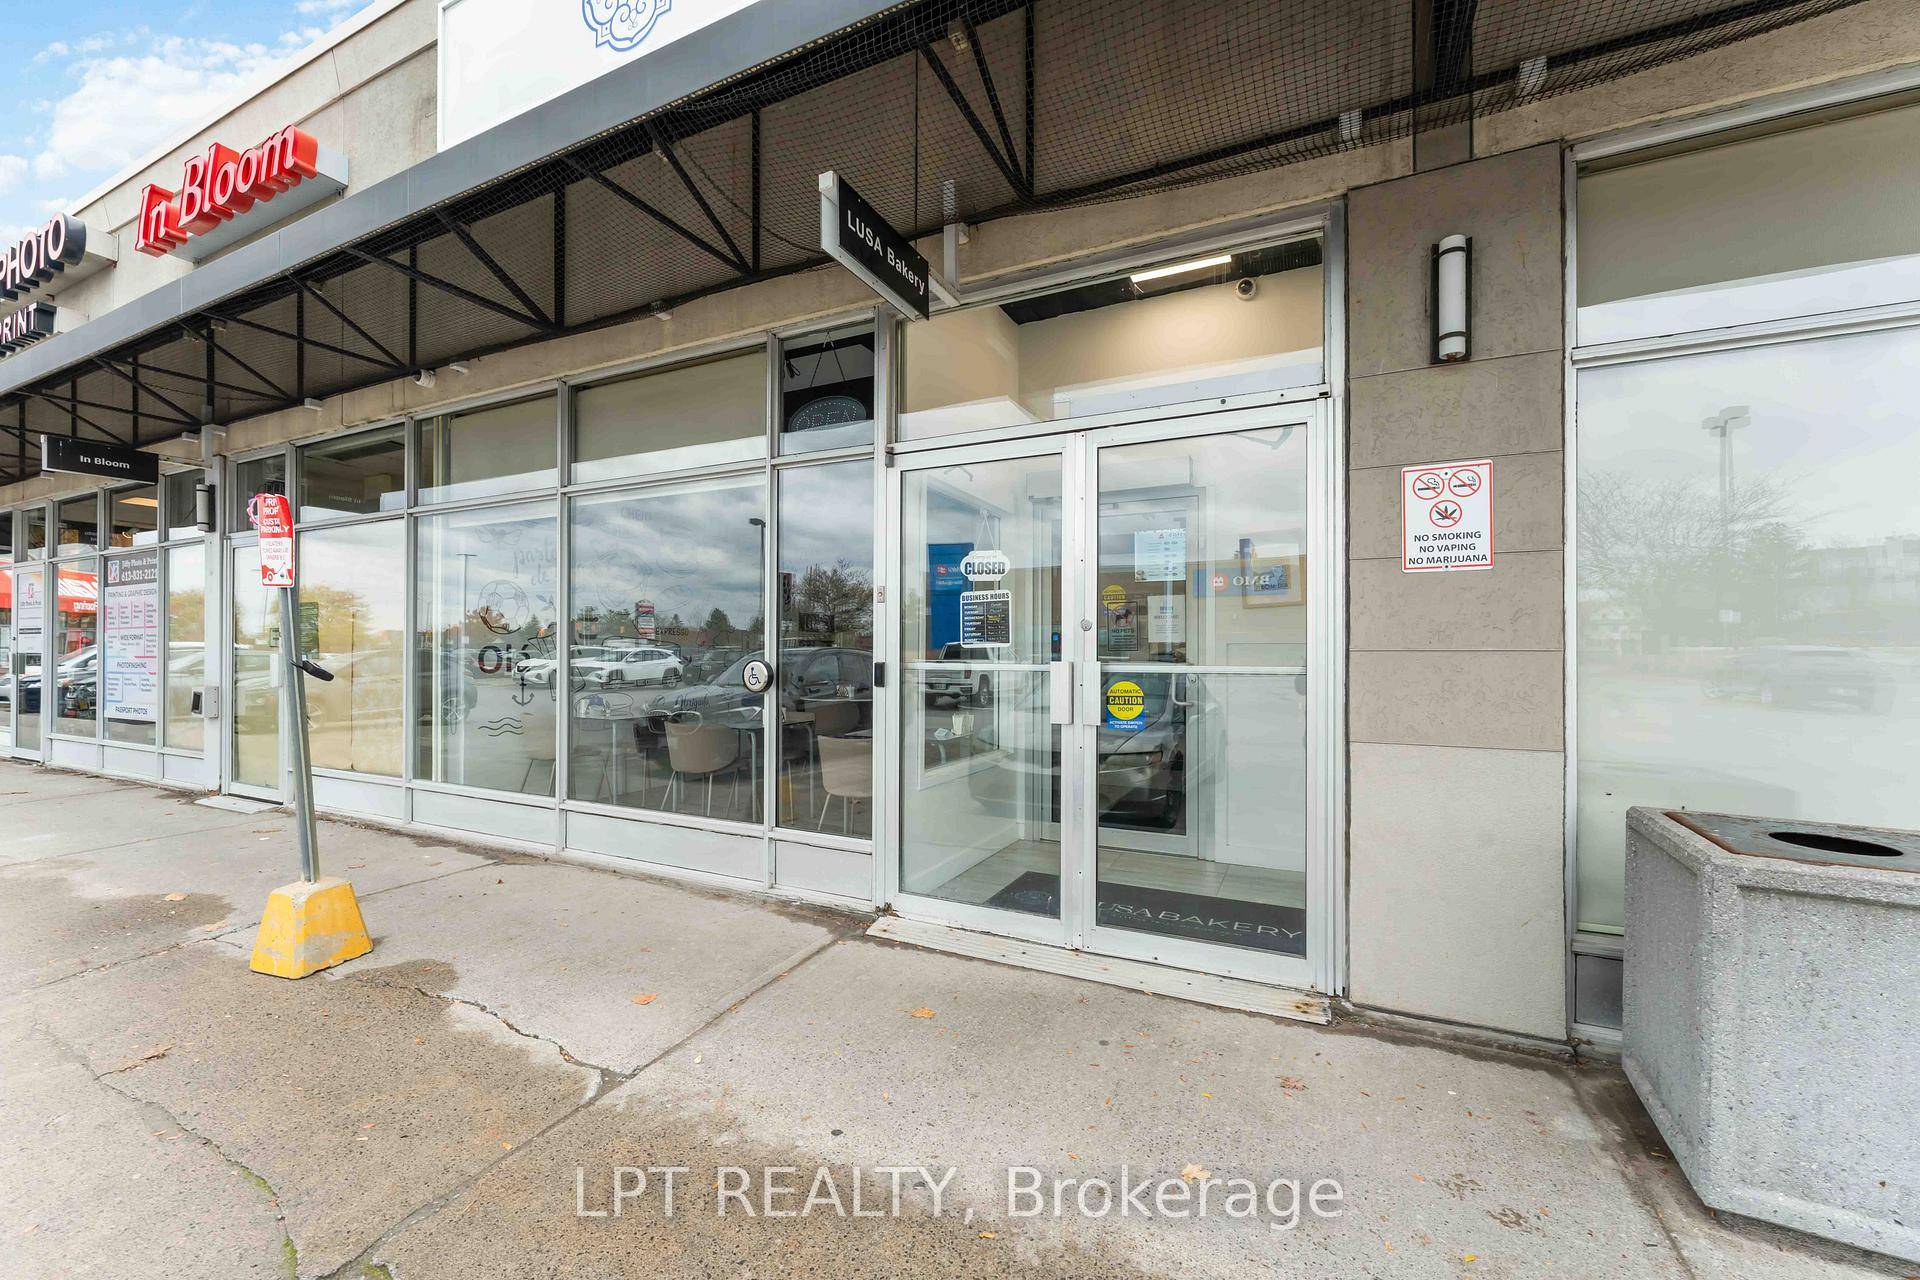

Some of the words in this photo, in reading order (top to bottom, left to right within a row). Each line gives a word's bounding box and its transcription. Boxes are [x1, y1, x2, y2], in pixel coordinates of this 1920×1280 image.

[134, 183, 172, 253] In
[178, 124, 304, 231] Bloom
[847, 209, 883, 257] LUSA
[887, 246, 926, 296] Bakery
[0, 302, 38, 344] RINT
[80, 455, 91, 464] In
[94, 457, 130, 470] Bloom
[1413, 534, 1430, 542] NO
[1432, 531, 1482, 542] SMOKING
[1419, 545, 1435, 553] NO
[1436, 542, 1477, 552] VAPING
[1408, 557, 1424, 565] NO
[1426, 554, 1488, 564] MARIJUANA
[964, 561, 1006, 576] CLOSED
[962, 593, 989, 601] BUSINESS
[989, 592, 1010, 600] HOURS
[1109, 696, 1143, 704] CAUTION
